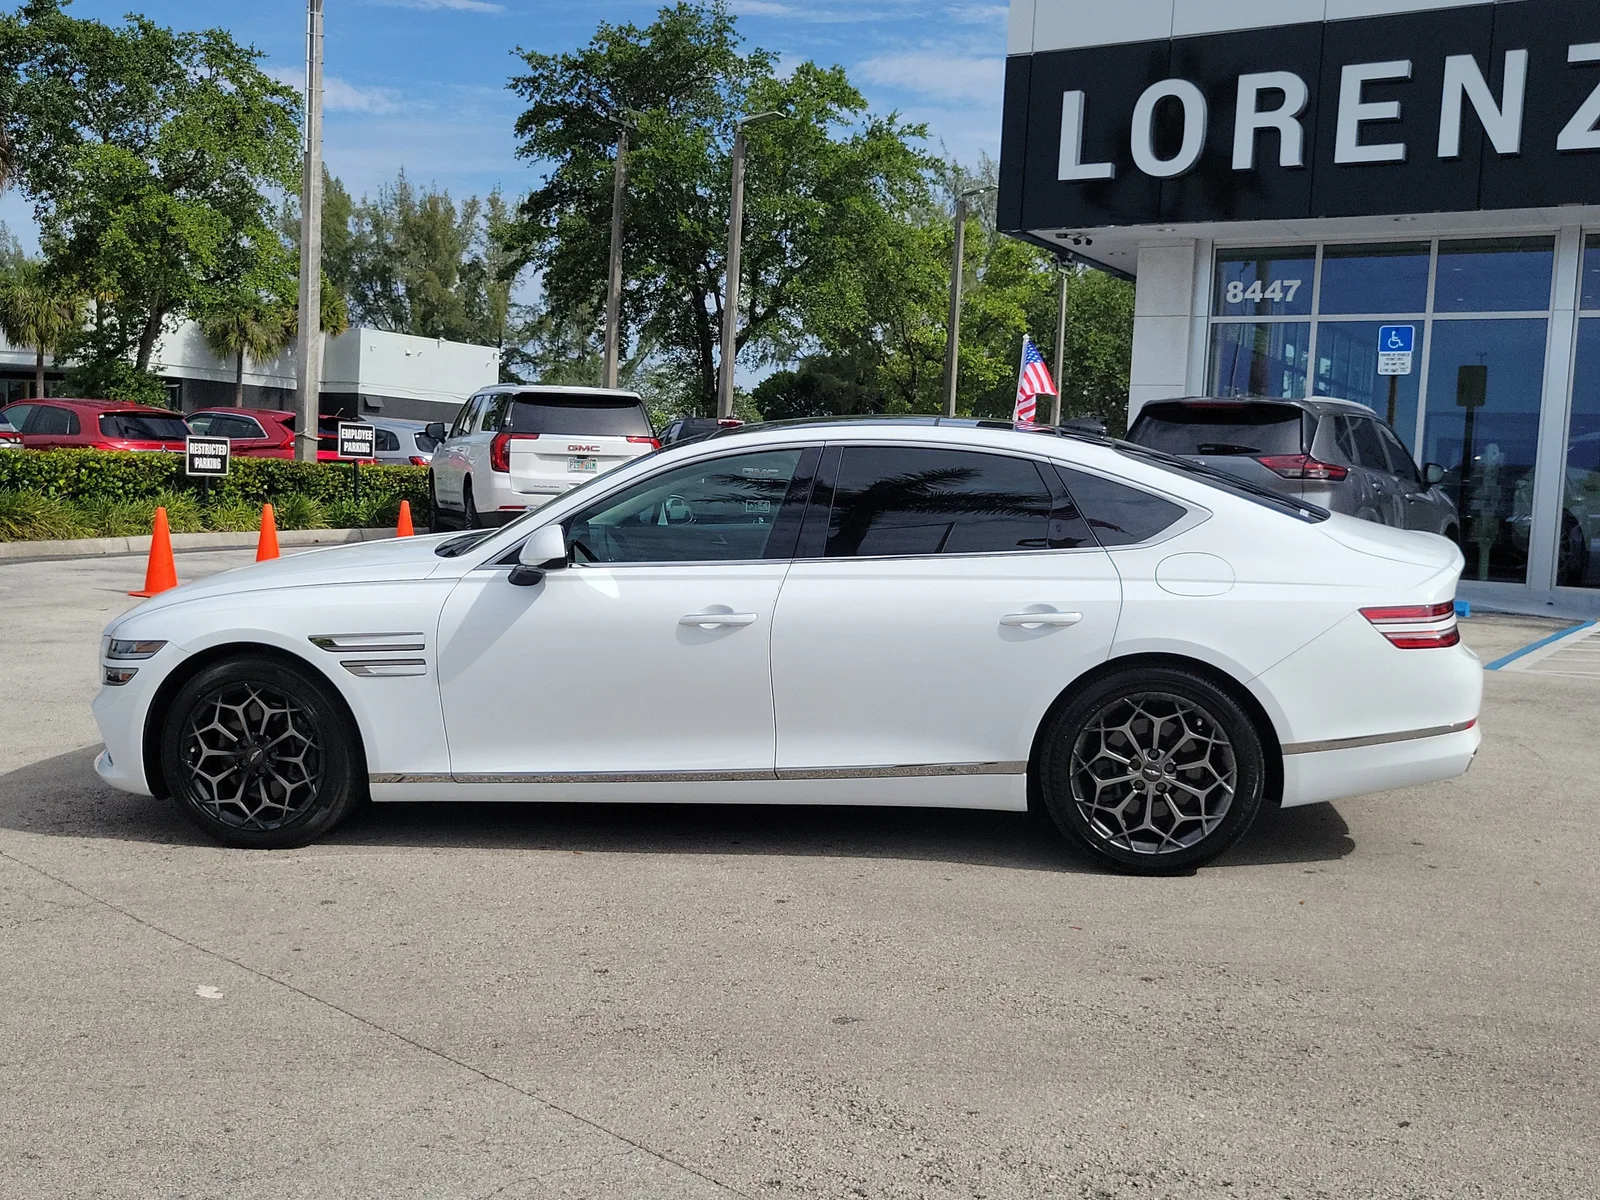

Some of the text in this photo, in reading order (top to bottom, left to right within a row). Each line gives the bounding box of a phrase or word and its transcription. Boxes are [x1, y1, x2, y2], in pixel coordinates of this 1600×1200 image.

[1226, 279, 1302, 304] 8447
[341, 428, 373, 440] EMPLOYEE
[189, 442, 227, 456] RESTRICTED
[343, 441, 370, 453] PARKING
[567, 444, 600, 452] GMC
[193, 457, 222, 469] PARKING
